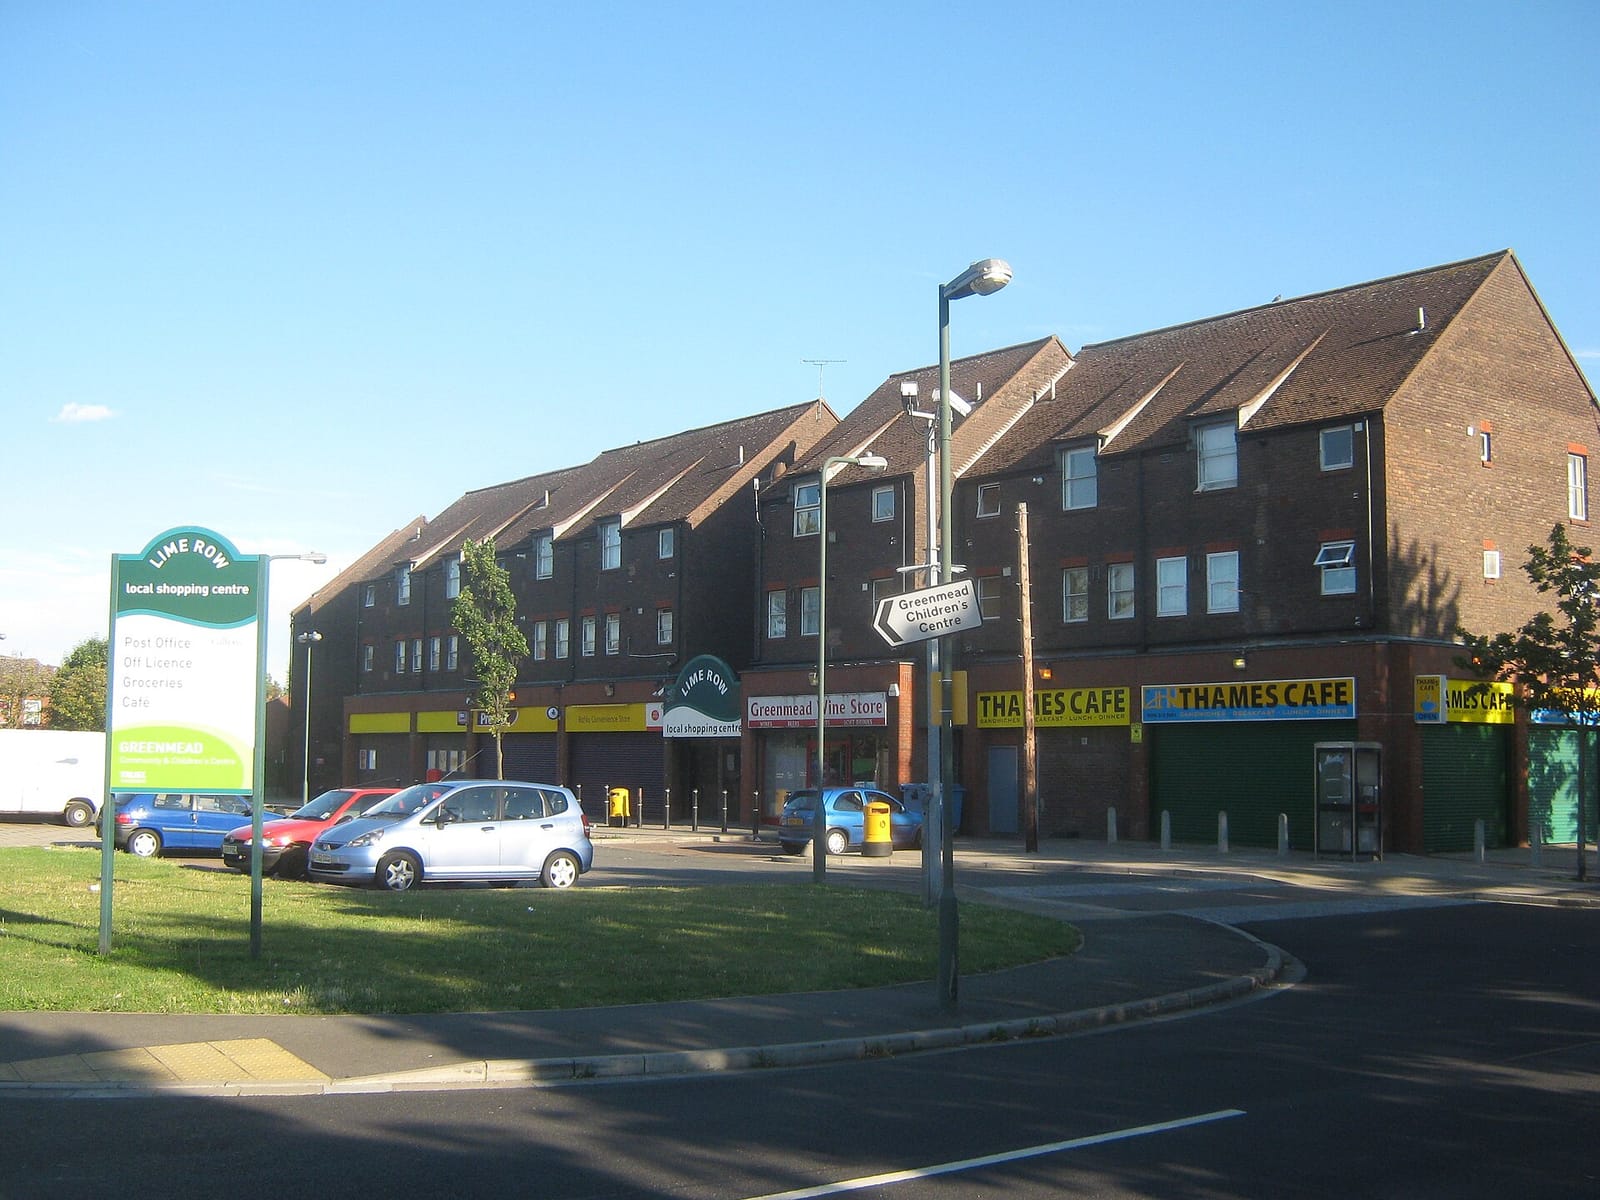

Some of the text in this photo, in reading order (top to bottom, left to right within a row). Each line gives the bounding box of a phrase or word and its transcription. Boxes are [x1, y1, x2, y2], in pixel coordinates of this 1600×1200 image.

[149, 538, 230, 569] LIME ROW
[126, 583, 250, 597] local shopping centre
[899, 584, 969, 610] Greenmead
[906, 600, 968, 622] Children's
[919, 616, 961, 633] Centre
[125, 636, 192, 649] Post Office
[123, 656, 193, 669] Off Licence
[123, 676, 183, 689] Groceries
[681, 669, 728, 697] LIME ROW
[980, 689, 1126, 718] THAES CAFE
[1179, 682, 1348, 710] THAMES CAFE
[1445, 689, 1478, 710] AMES
[750, 702, 812, 717] Greenmead
[850, 698, 882, 714] Store
[666, 724, 742, 735] local shopping centre
[119, 741, 203, 754] GREENMEAD
